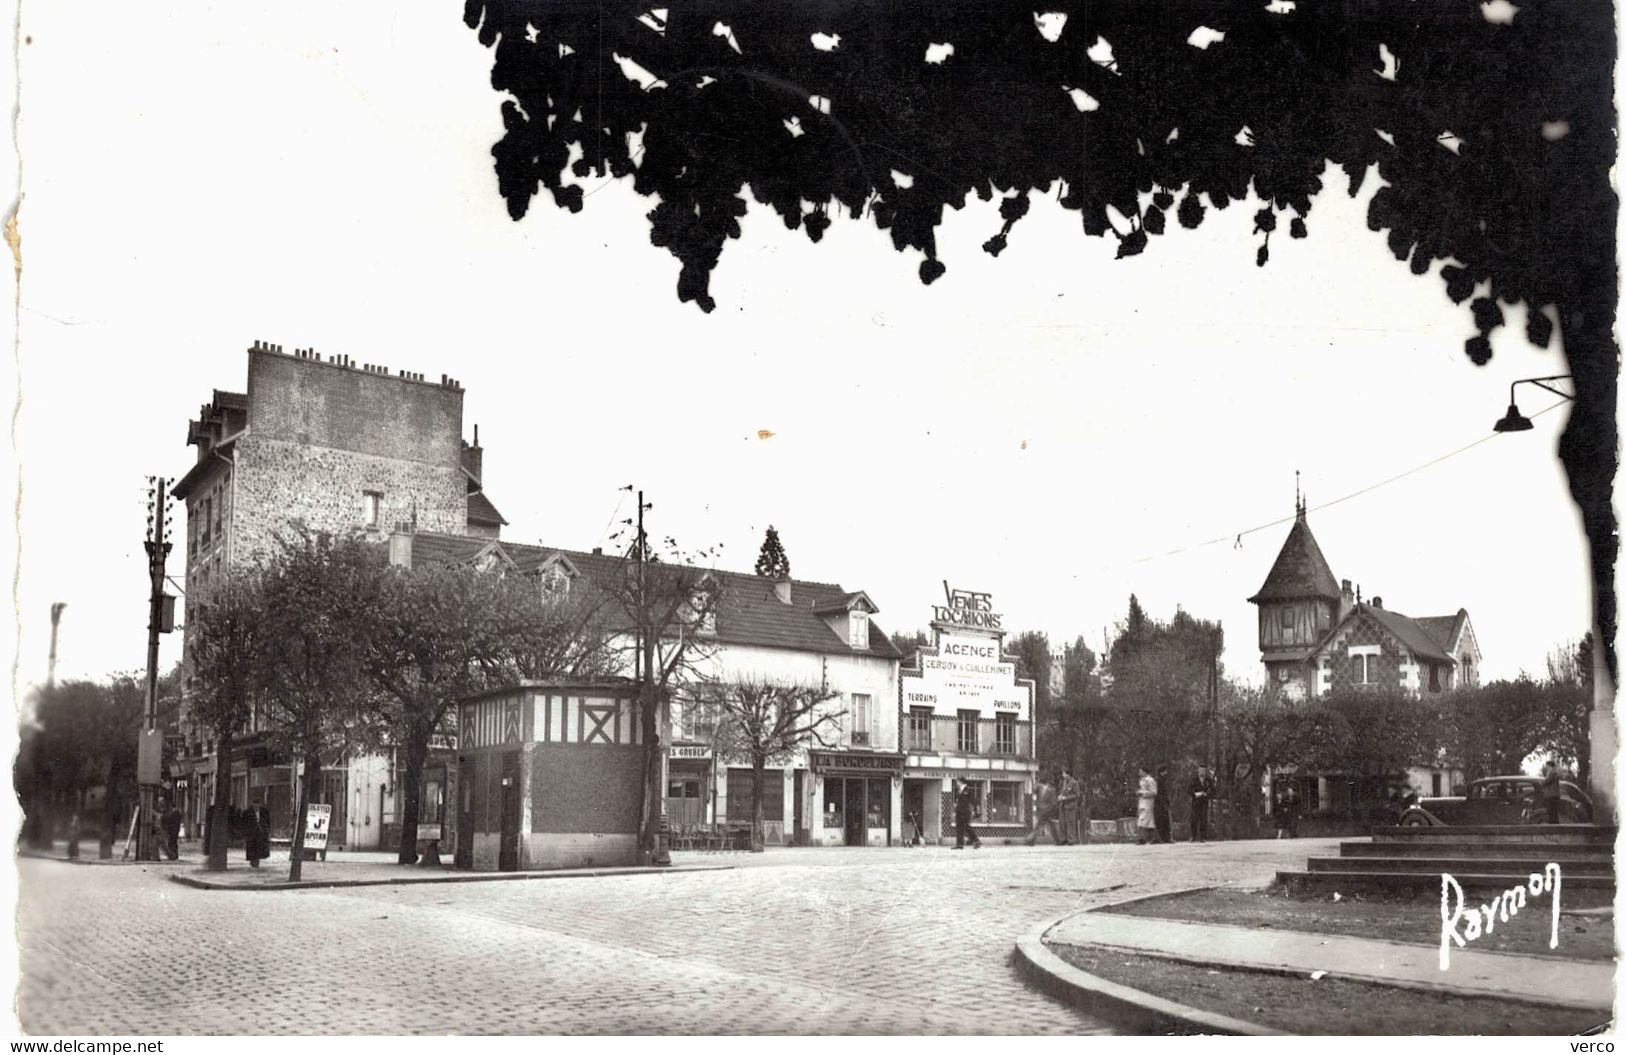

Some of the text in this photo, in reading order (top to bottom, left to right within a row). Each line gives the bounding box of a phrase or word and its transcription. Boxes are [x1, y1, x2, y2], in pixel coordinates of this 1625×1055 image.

[943, 579, 993, 612] VENTES
[931, 605, 1002, 628] LOCATIONS
[944, 643, 995, 658] AGENCE
[908, 692, 938, 703] TERRAINS
